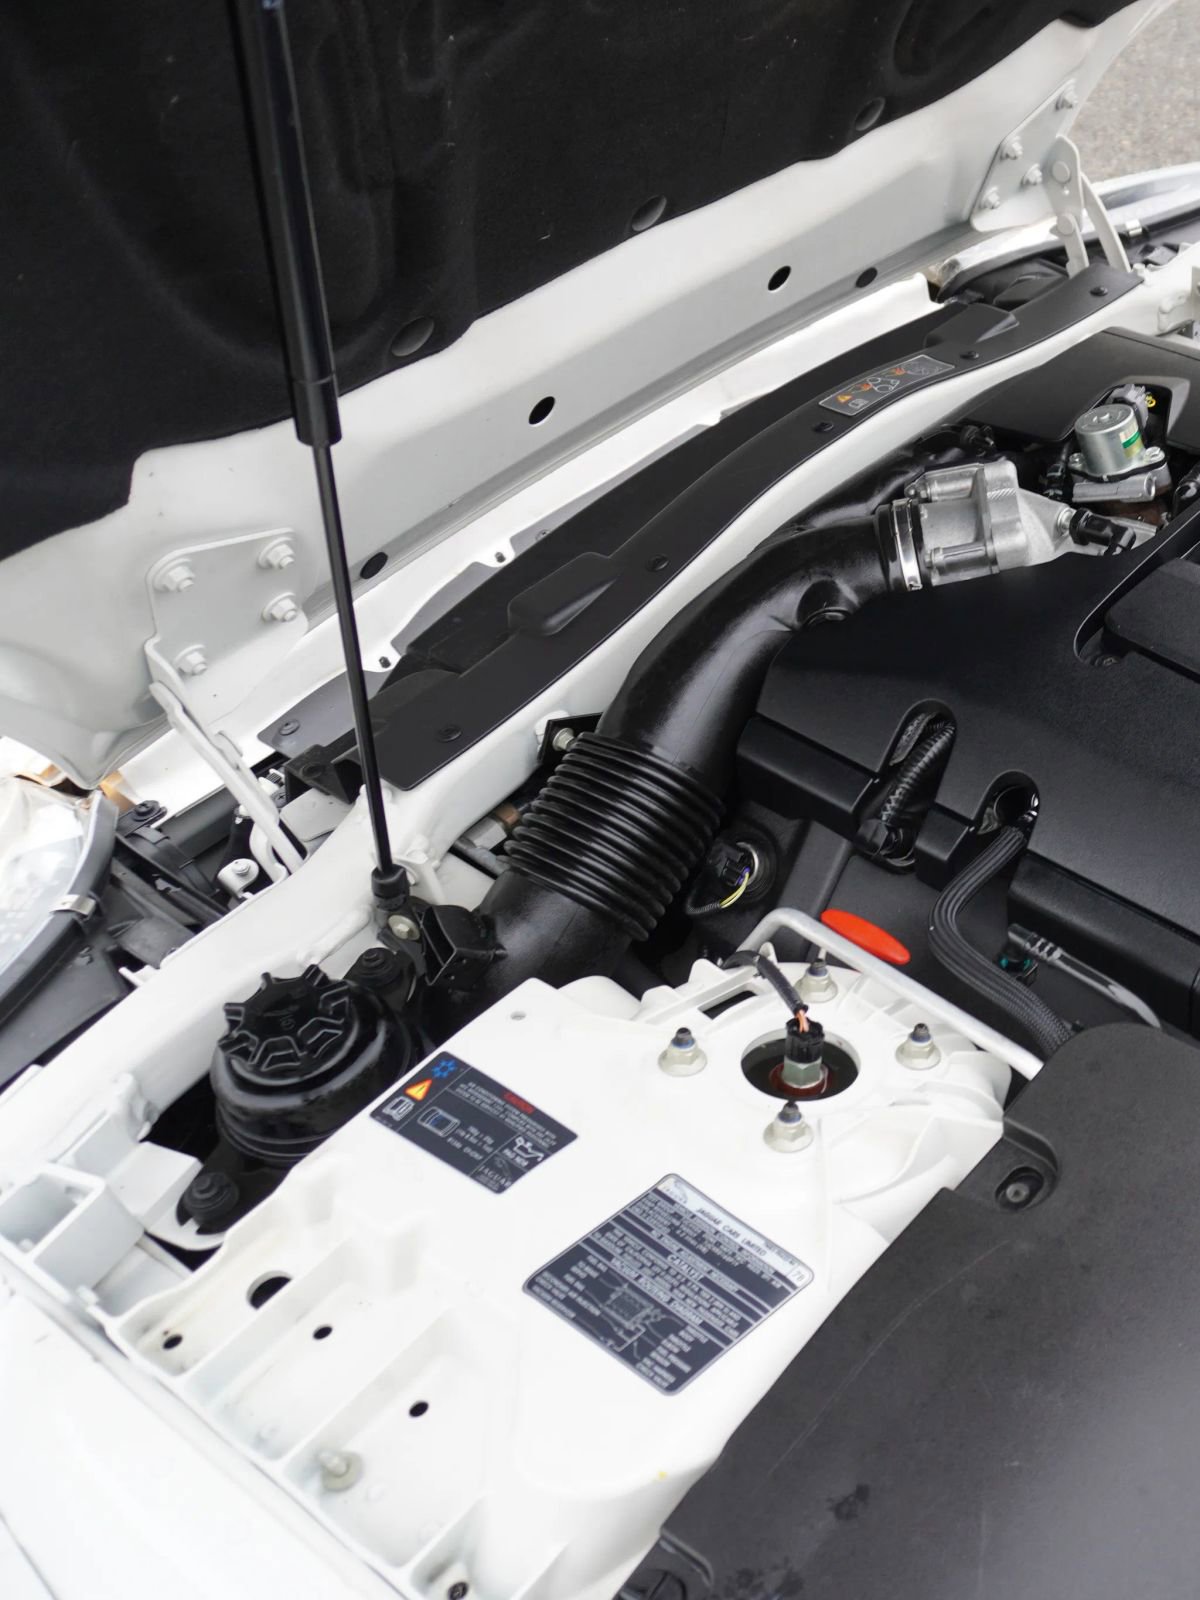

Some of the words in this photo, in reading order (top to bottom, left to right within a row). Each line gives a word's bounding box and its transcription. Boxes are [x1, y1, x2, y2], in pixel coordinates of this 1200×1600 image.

[695, 1206, 722, 1226] JAGUAR
[720, 1224, 741, 1239] CARS
[740, 1237, 767, 1257] LIMITED
[665, 1253, 703, 1281] CATALYST
